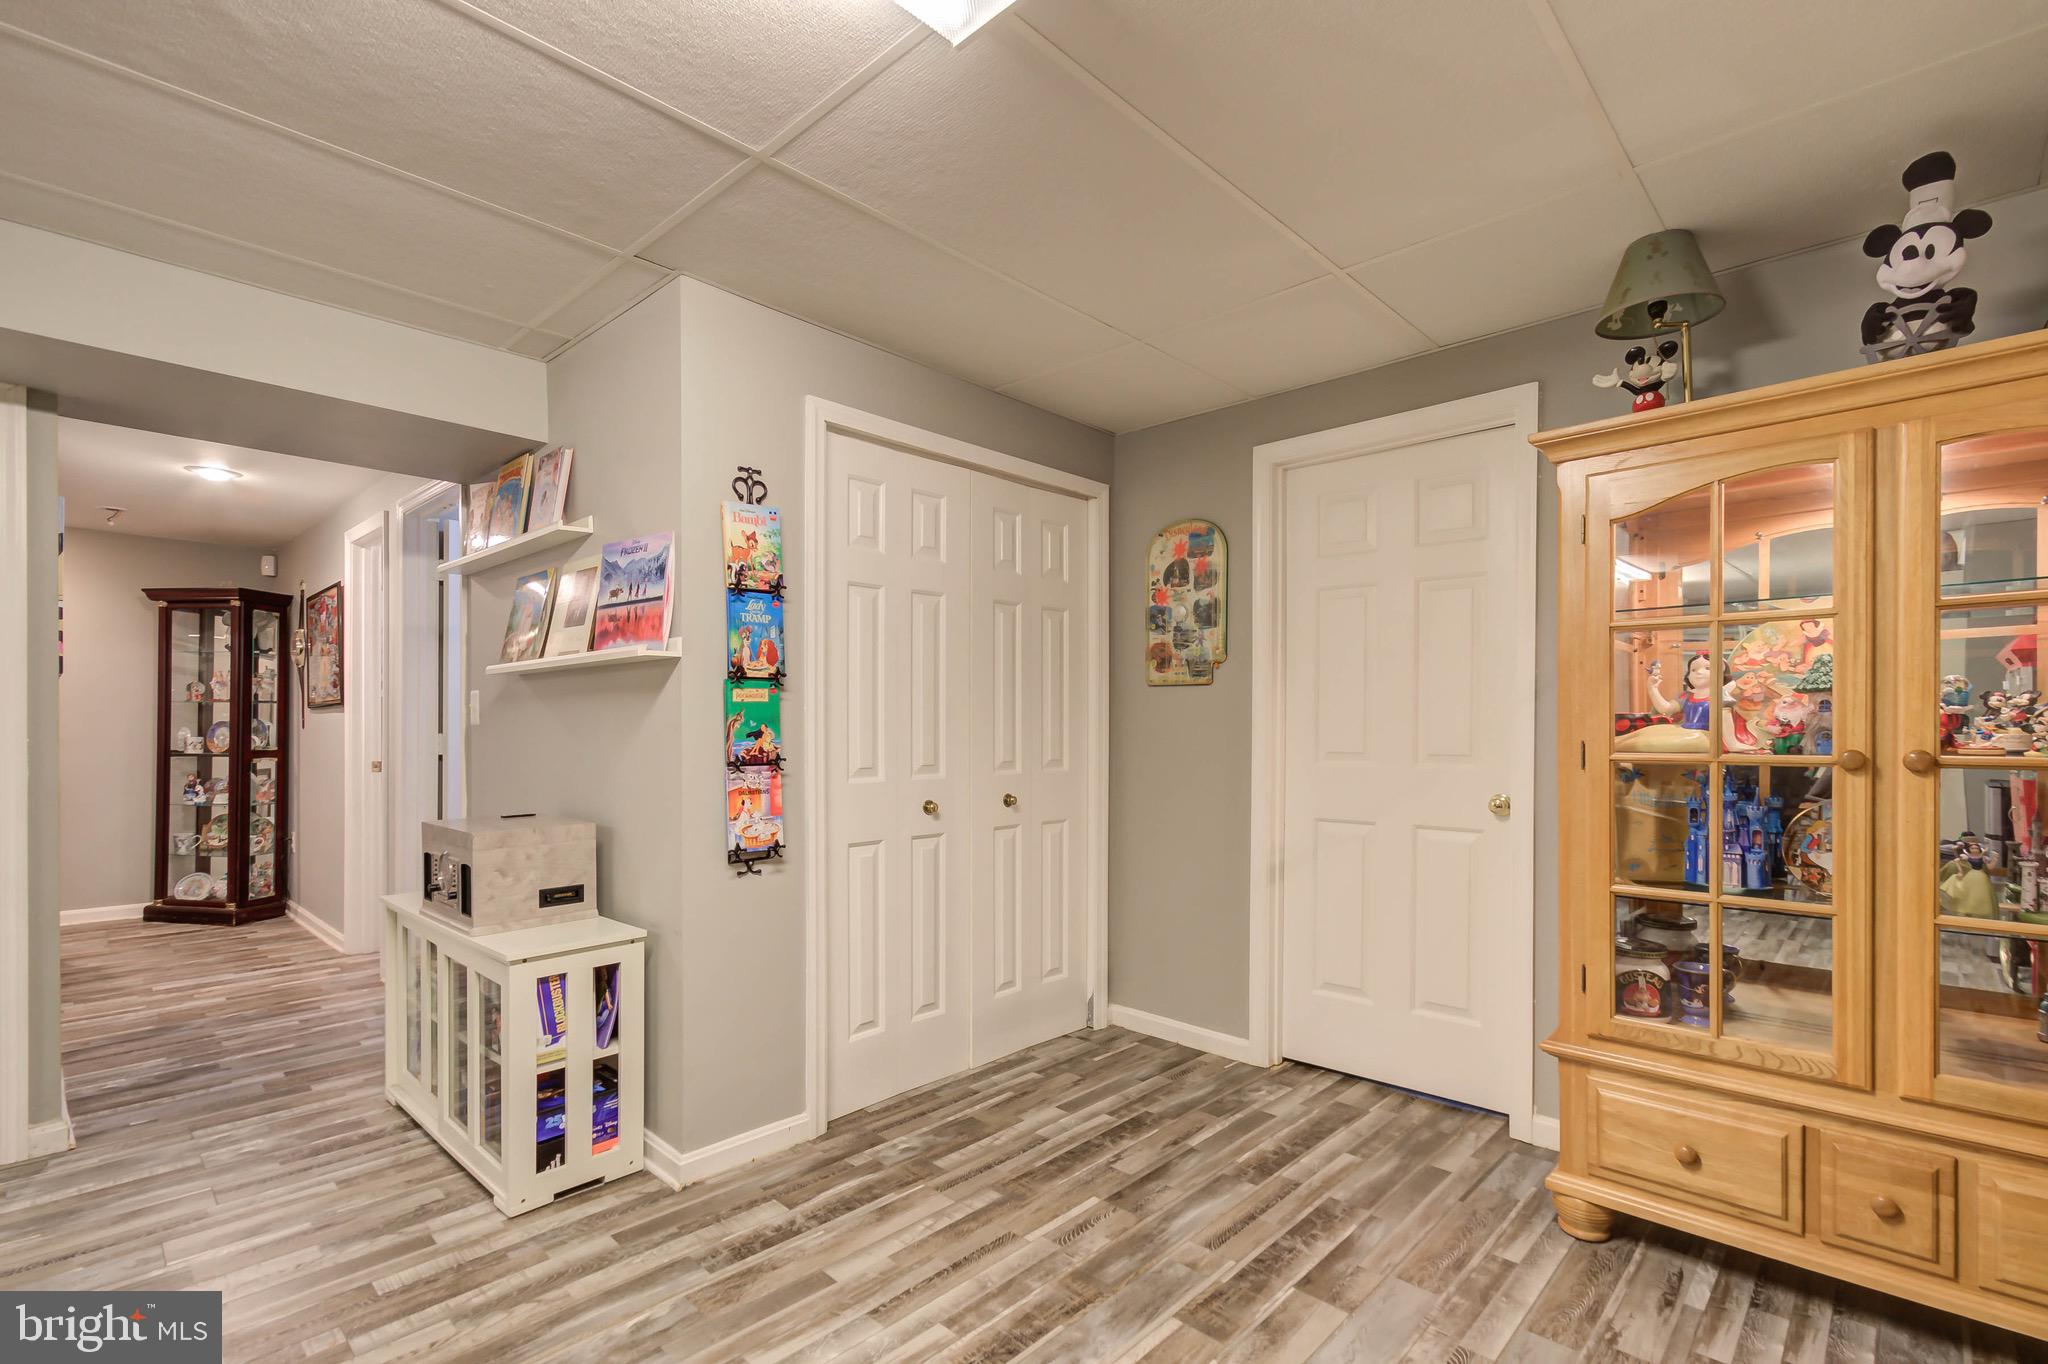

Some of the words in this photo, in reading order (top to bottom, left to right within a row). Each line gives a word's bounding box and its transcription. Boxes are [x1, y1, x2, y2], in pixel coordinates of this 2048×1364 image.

[733, 511, 767, 526] Bambi
[620, 545, 643, 557] FROZEN
[745, 598, 766, 612] Lady
[740, 612, 772, 624] TRAMP
